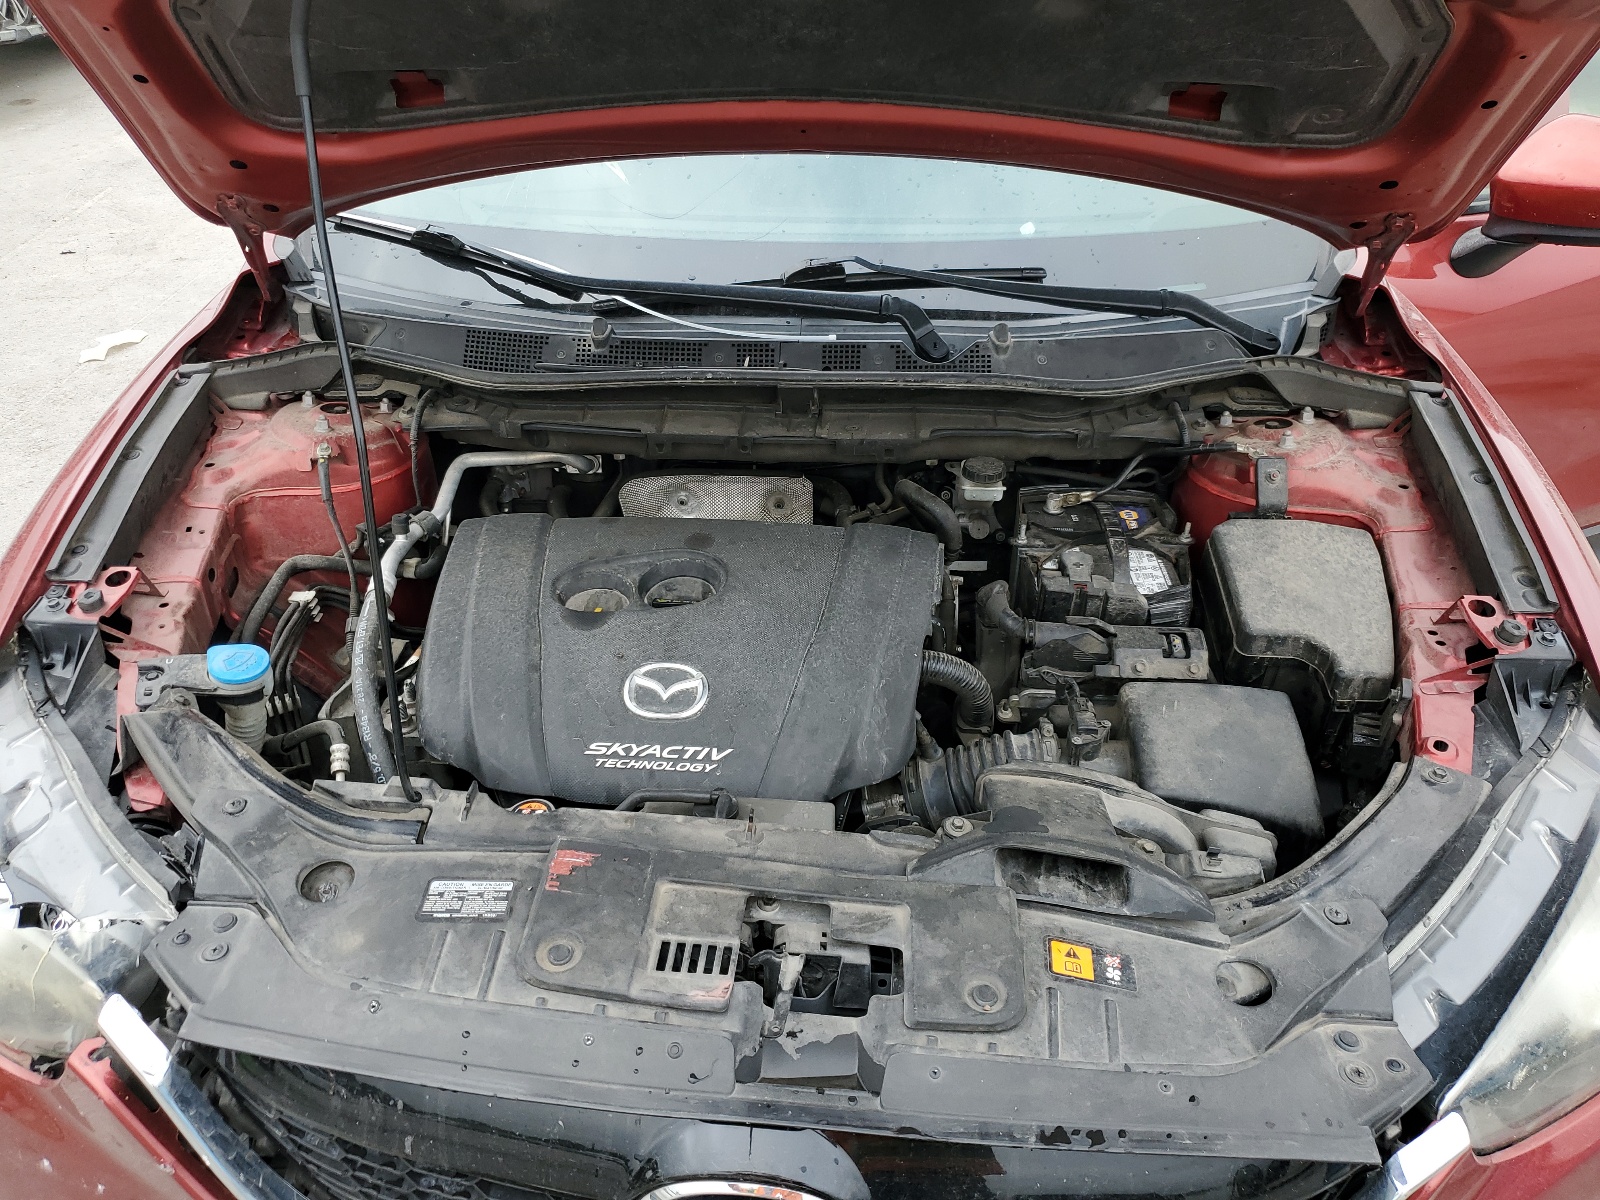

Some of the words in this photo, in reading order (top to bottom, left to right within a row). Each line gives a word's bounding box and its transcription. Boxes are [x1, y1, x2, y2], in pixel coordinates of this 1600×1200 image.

[361, 715, 371, 742] R134a
[584, 742, 735, 761] SKYACTIV
[594, 758, 718, 773] TECHNOLOGY
